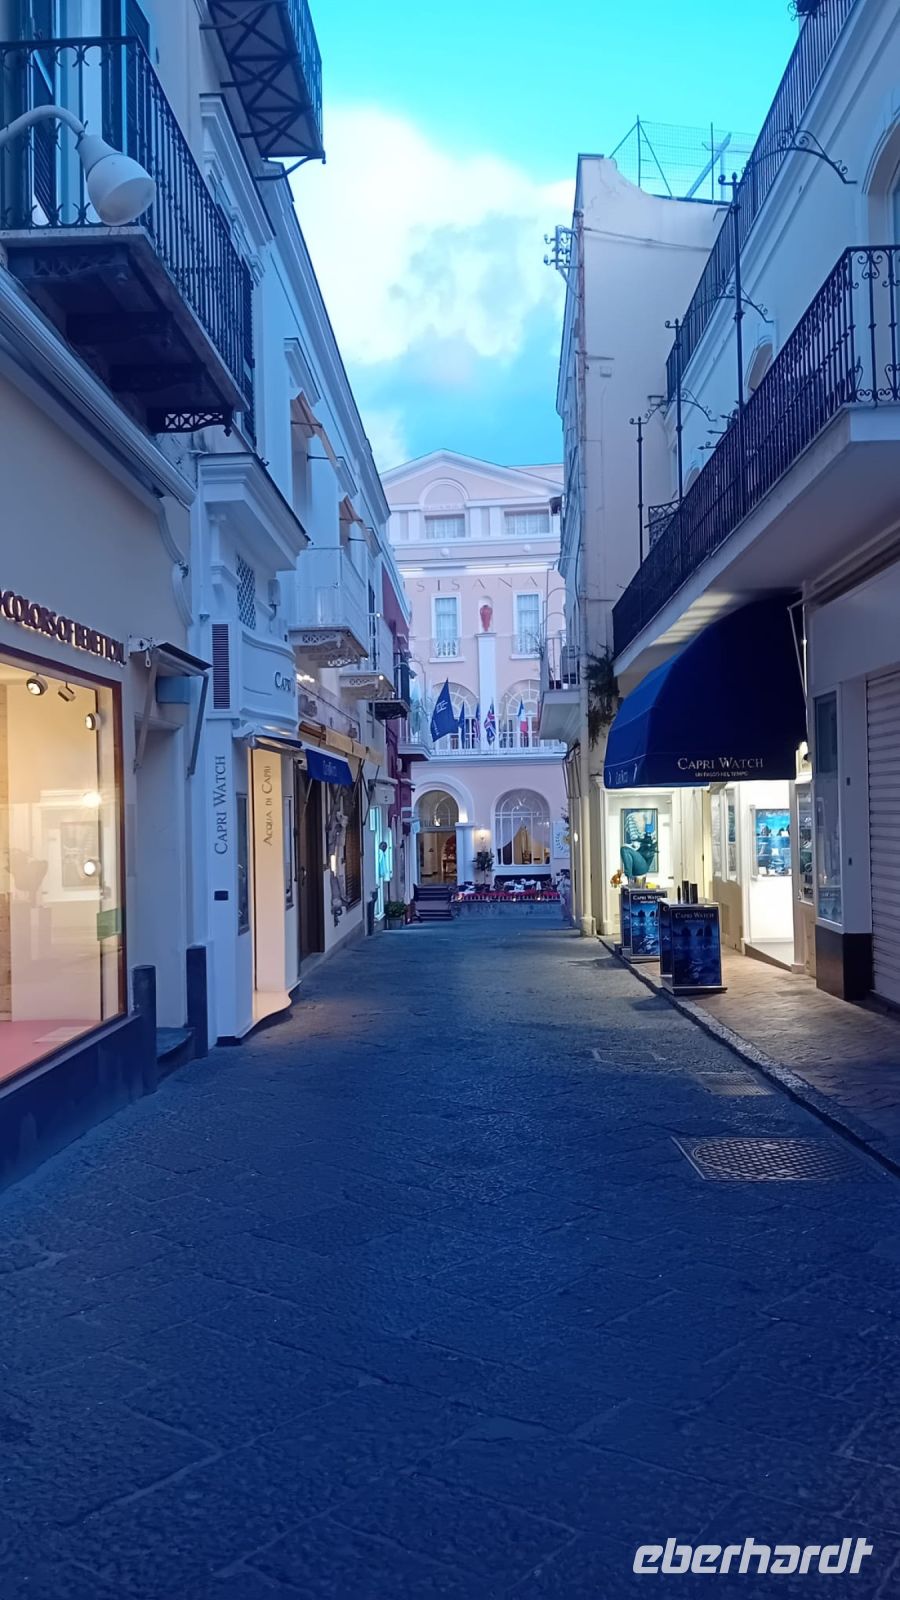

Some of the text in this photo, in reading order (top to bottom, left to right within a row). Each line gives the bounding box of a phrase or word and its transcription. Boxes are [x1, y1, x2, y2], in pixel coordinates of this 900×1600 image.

[262, 765, 272, 794] CAPRI
[677, 757, 764, 770] CAPRI WATCH
[213, 756, 228, 855] CAPRI WATCH
[263, 810, 273, 846] ACQUA
